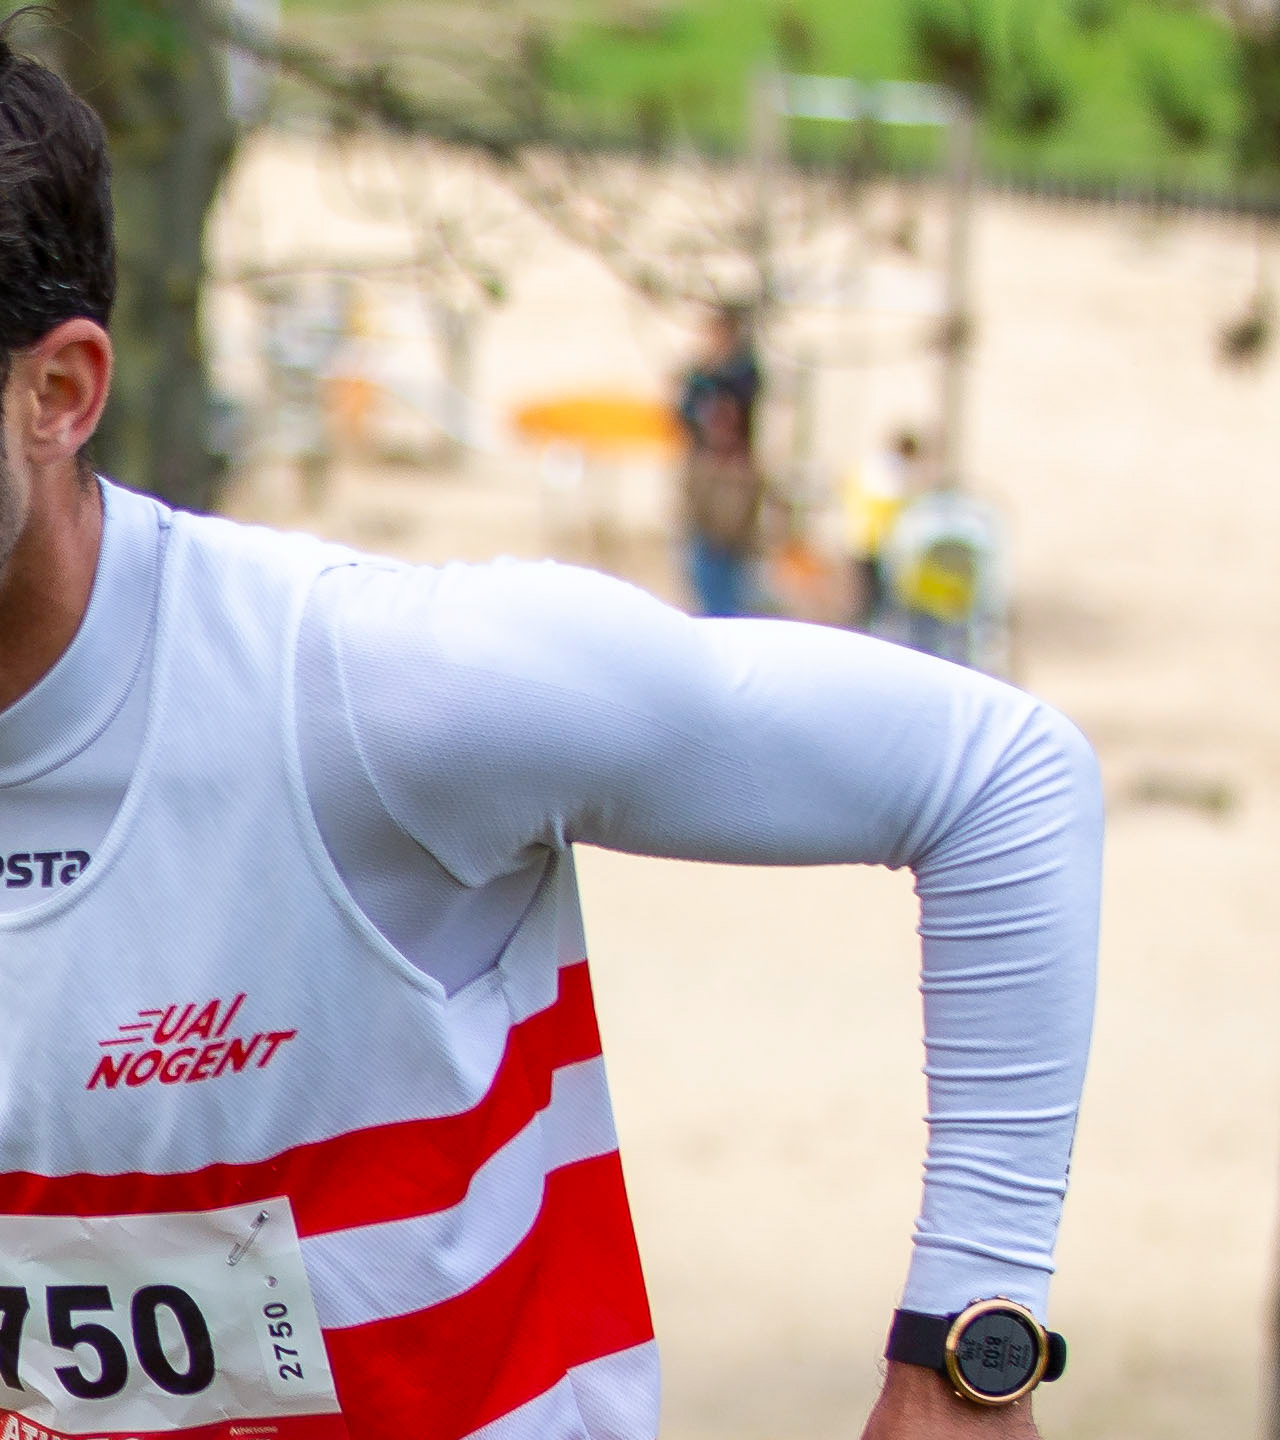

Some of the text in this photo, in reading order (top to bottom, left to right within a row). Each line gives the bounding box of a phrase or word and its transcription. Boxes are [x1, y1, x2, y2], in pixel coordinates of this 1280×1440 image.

[152, 992, 248, 1046] UAI
[84, 1028, 298, 1091] NOGENT
[263, 1301, 305, 1382] 2750
